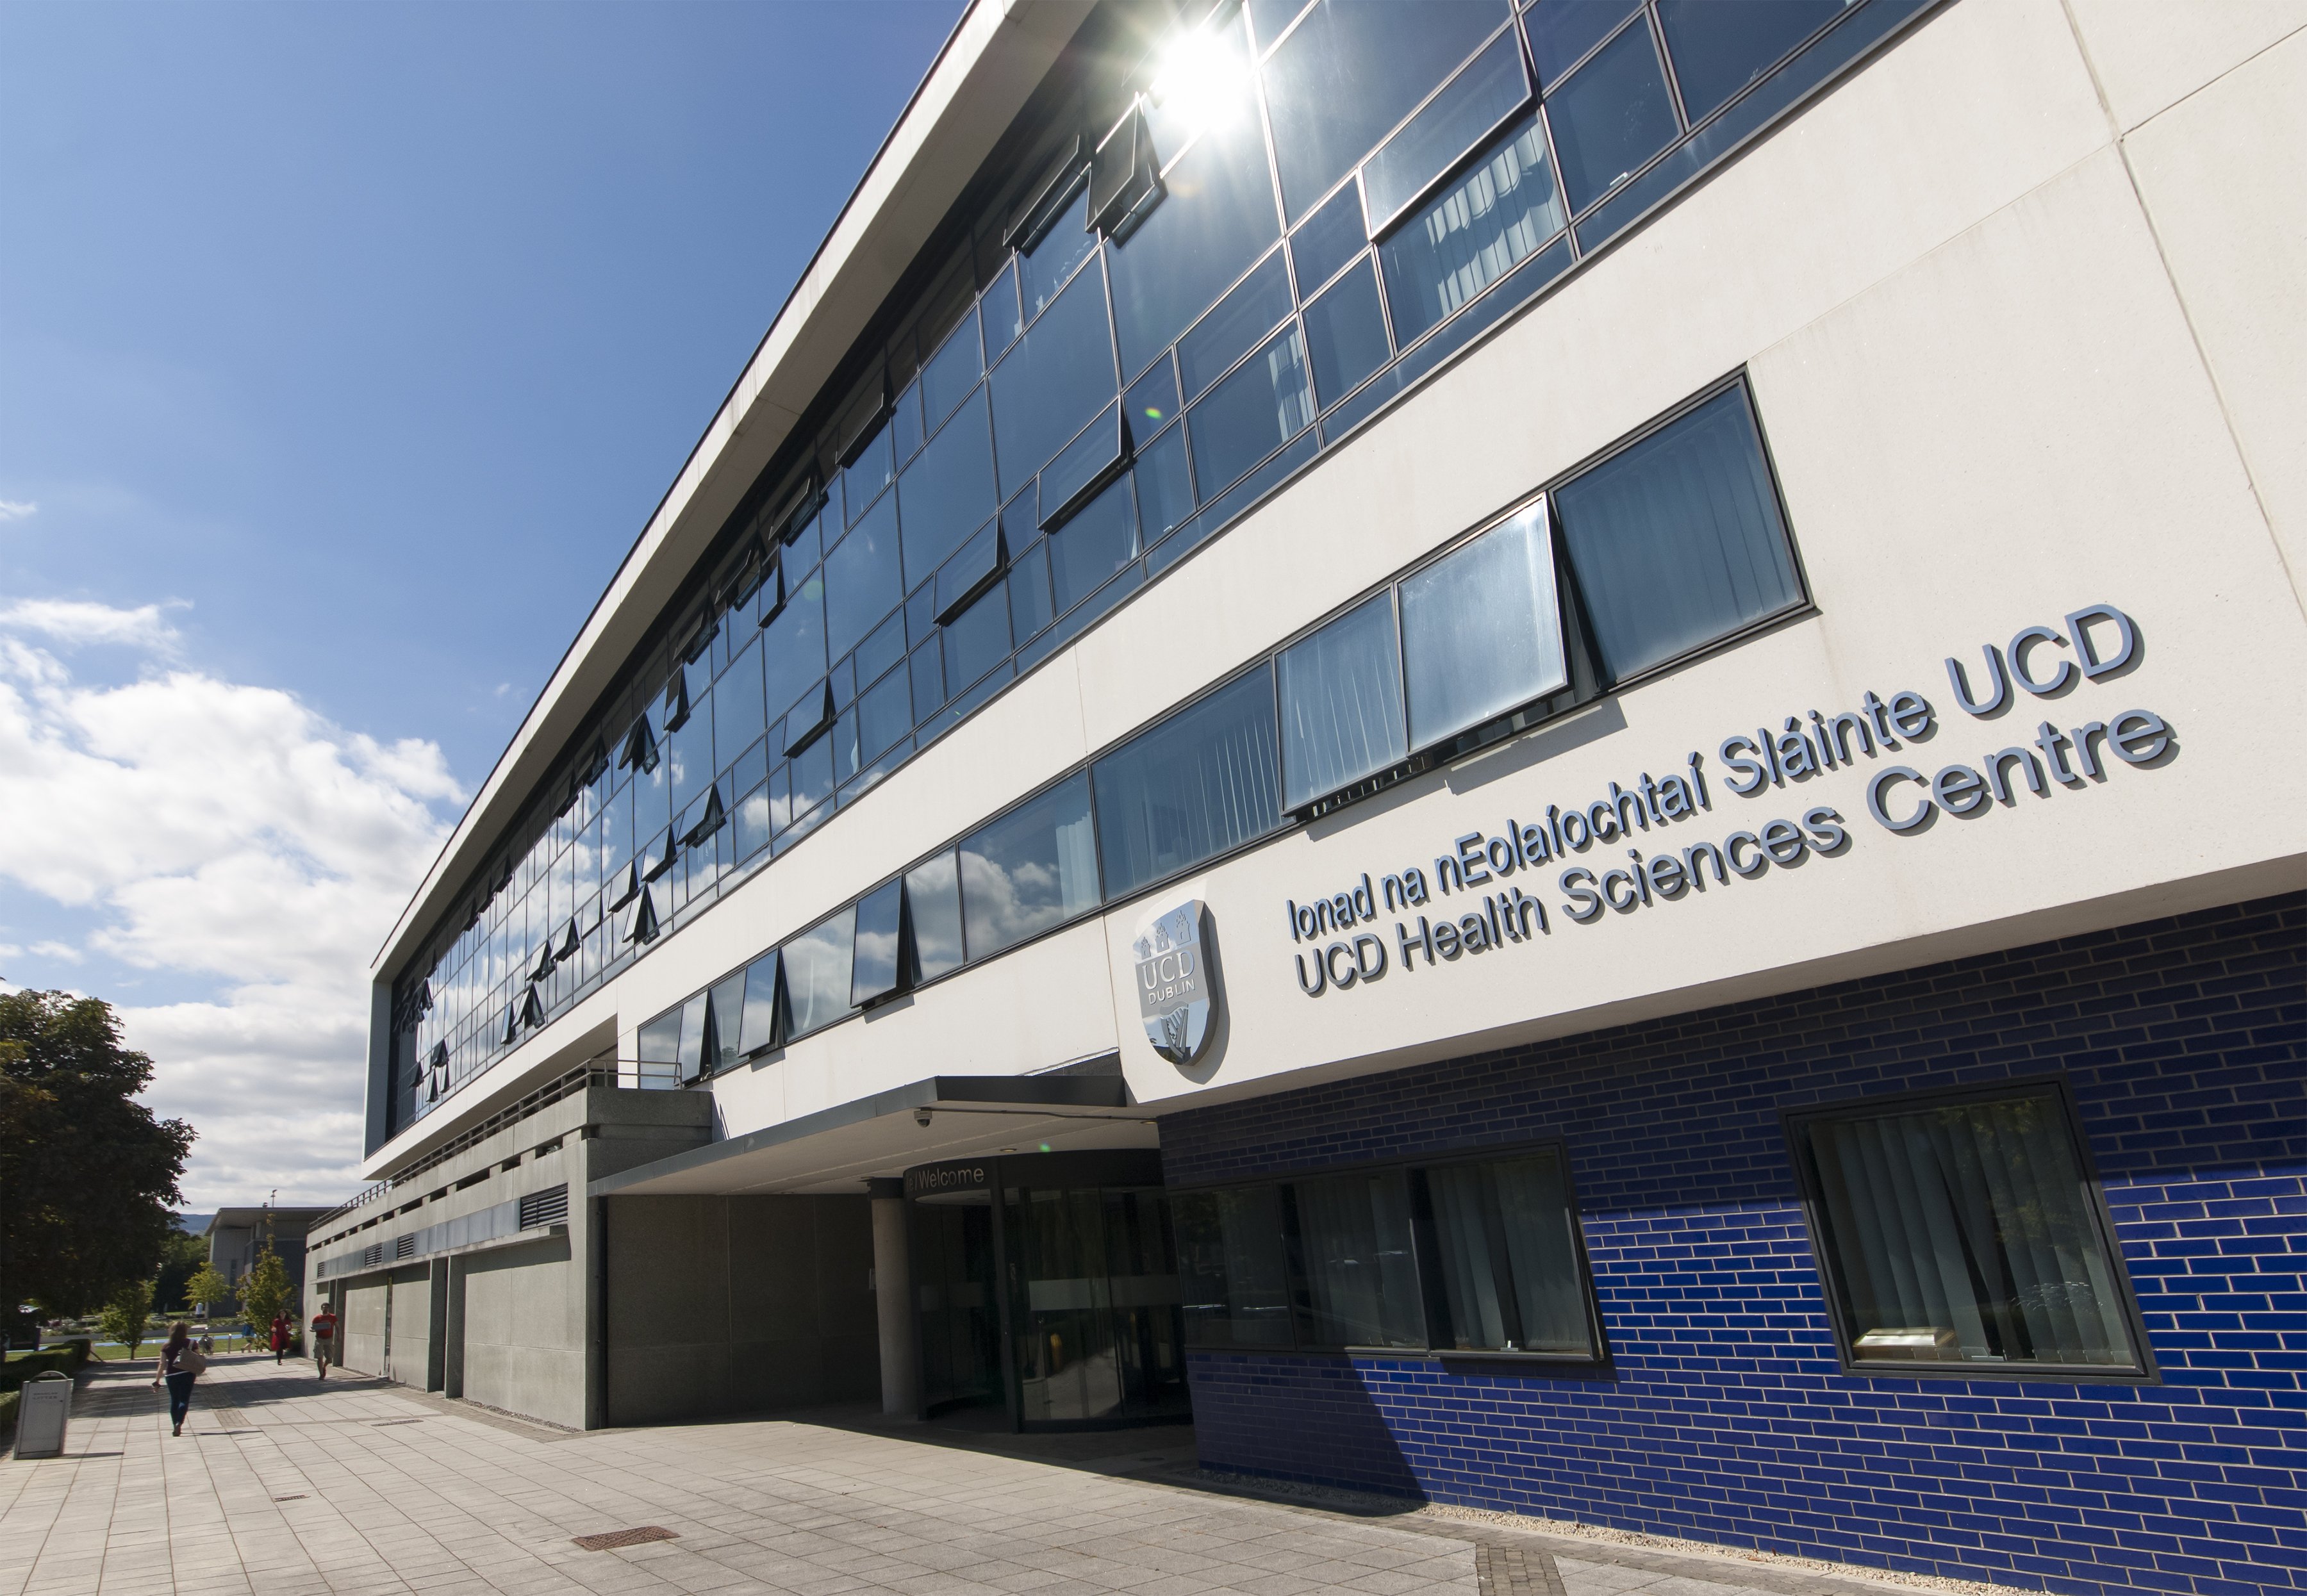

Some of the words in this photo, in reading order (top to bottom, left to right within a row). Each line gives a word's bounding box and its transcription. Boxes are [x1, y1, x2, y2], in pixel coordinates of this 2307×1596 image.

[1286, 873, 1373, 940] Ionad
[1380, 867, 1424, 909] na
[1434, 751, 1706, 892] nEolaíochtaí
[1719, 690, 1930, 793] Sláinte
[1944, 604, 2135, 715] UCD
[1294, 933, 1385, 994] UCD
[1395, 887, 1546, 967] Health
[1559, 806, 1846, 920] Sciences
[1866, 709, 2170, 831] Centre
[1142, 949, 1195, 990] UCD
[1148, 978, 1195, 1005] DUBLIN
